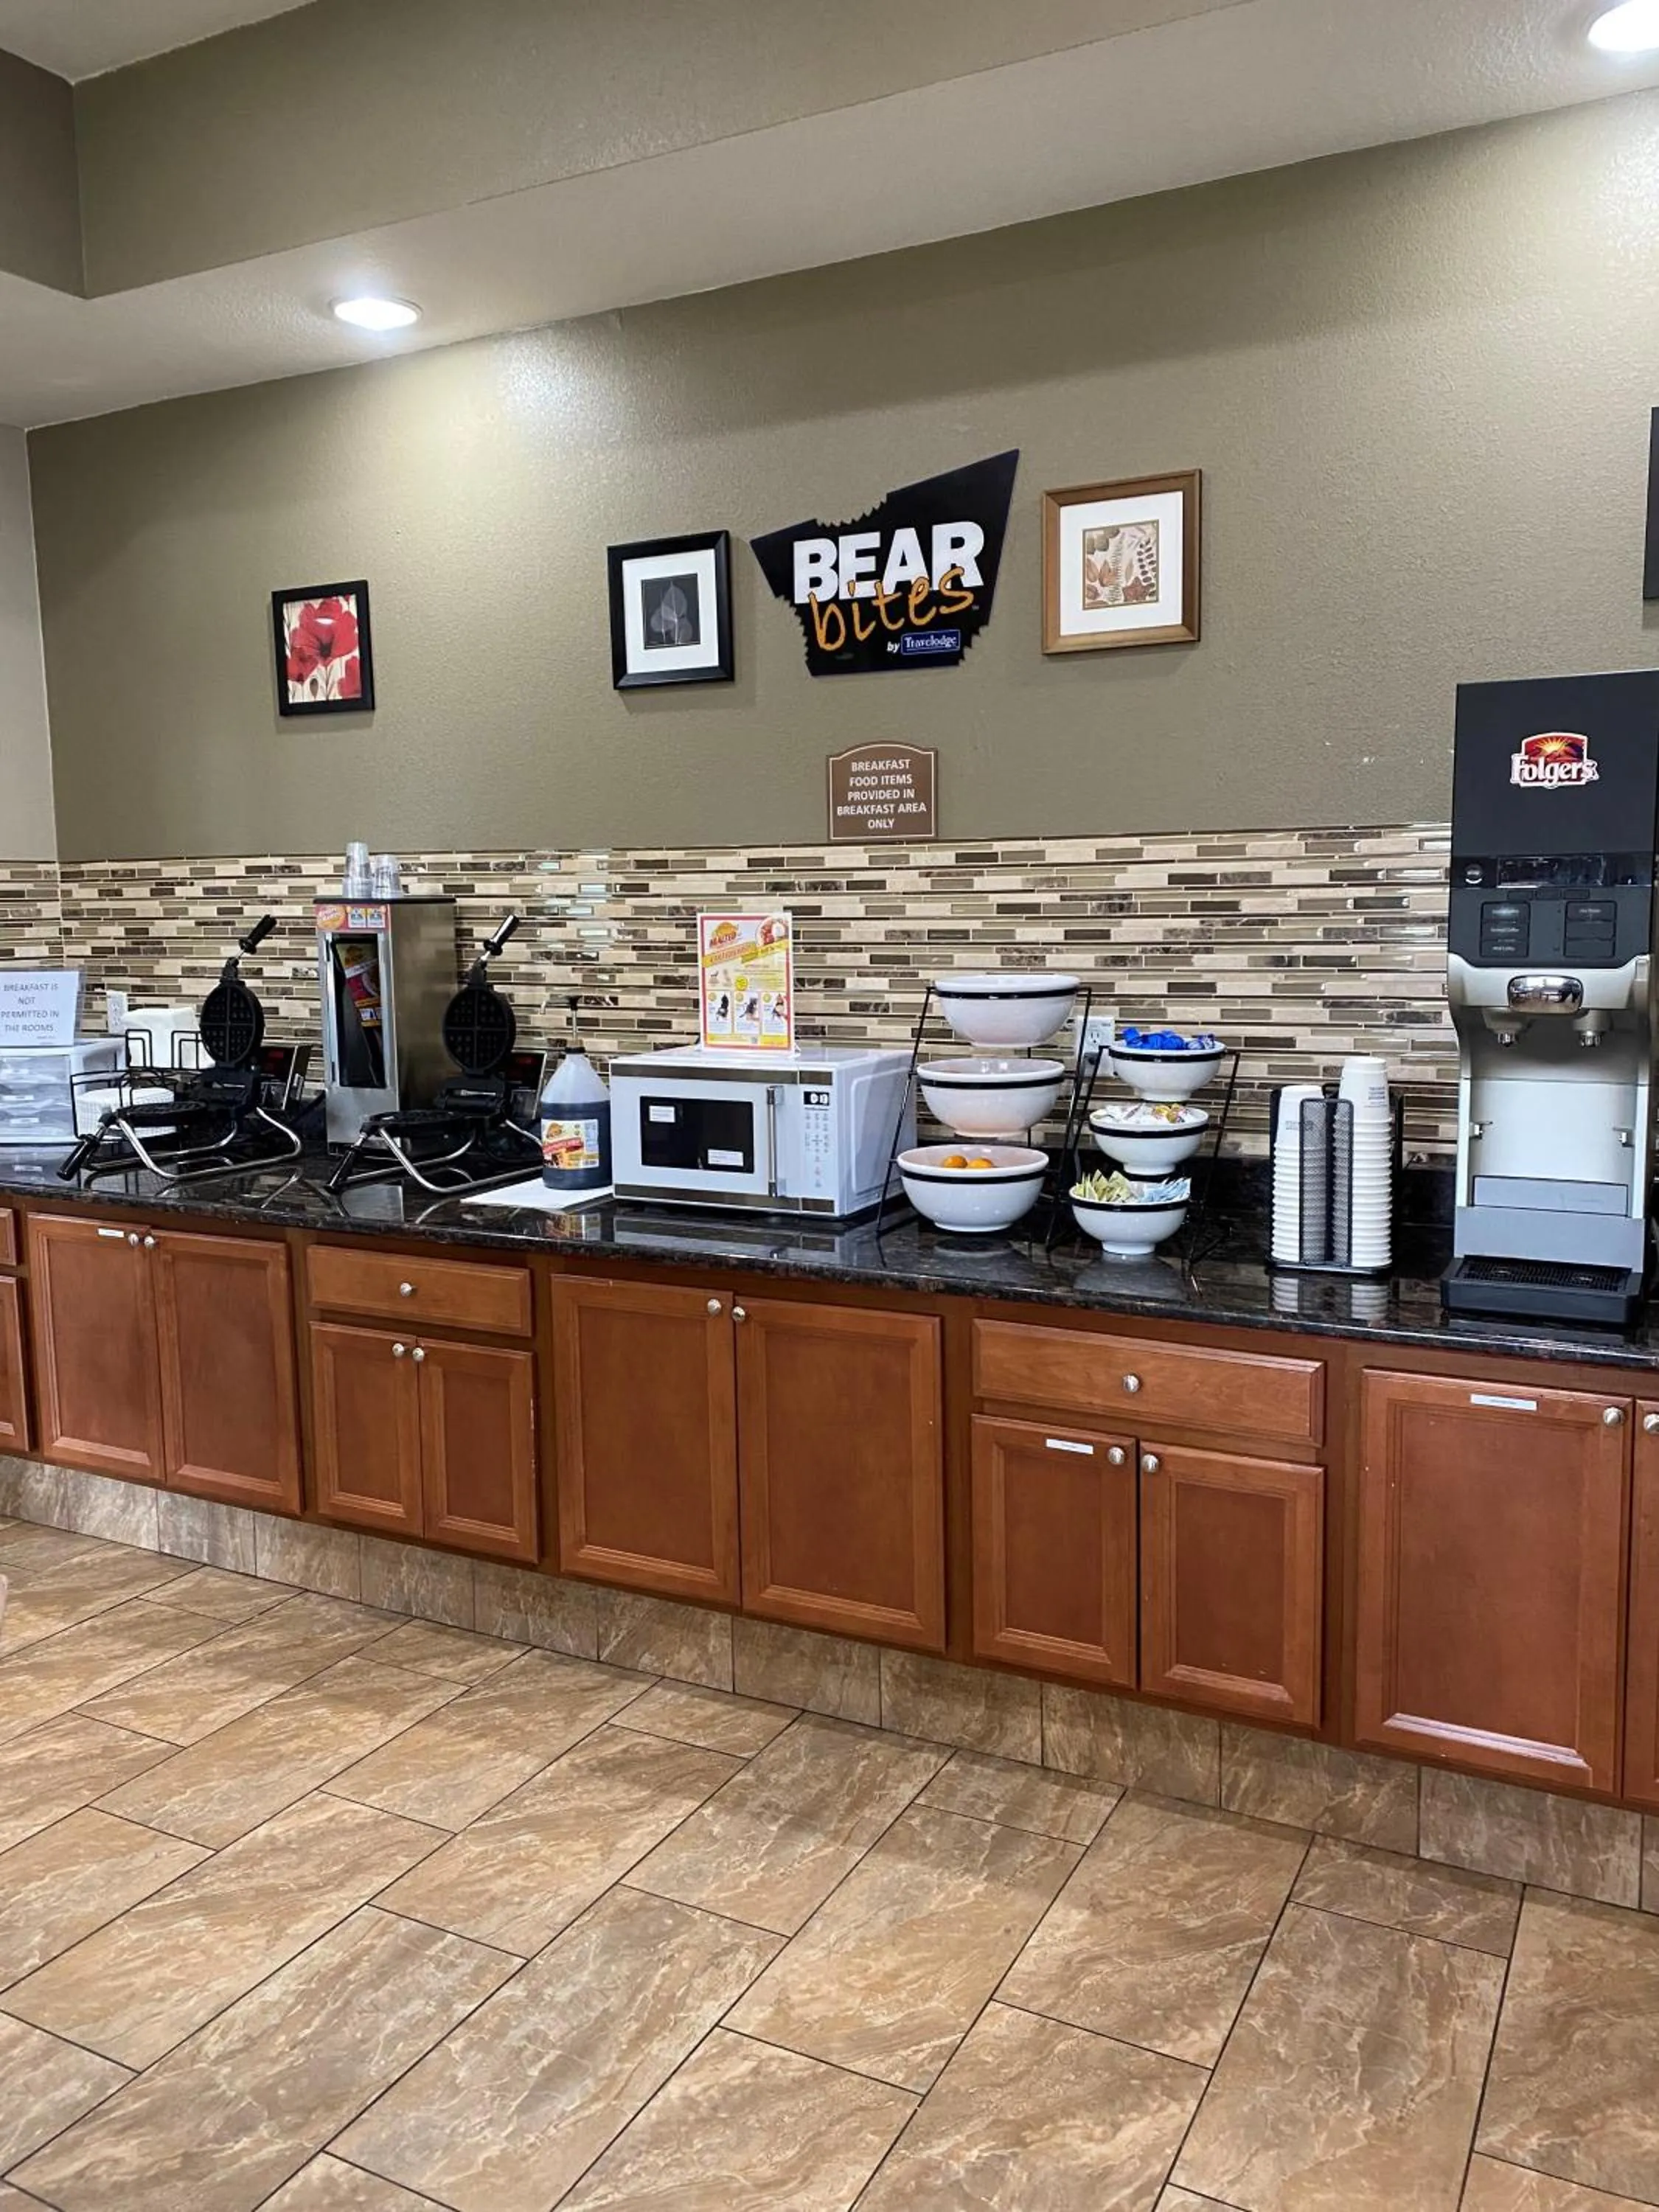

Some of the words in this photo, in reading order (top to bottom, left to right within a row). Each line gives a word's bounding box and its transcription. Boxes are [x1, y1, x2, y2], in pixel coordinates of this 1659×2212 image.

[793, 521, 984, 605] BEAR
[808, 567, 974, 651] bites
[886, 641, 900, 653] by
[904, 633, 958, 649] Travelodge
[852, 759, 911, 772] BREAKFAST
[1510, 753, 1598, 787] Folgers
[849, 776, 878, 787] FOOD
[881, 774, 913, 785] ITEMS
[848, 790, 900, 801] PROVIDED
[903, 788, 915, 799] IN
[837, 804, 895, 816] BREAKFAST
[897, 801, 927, 813] AREA
[868, 818, 894, 830] ONLY
[4, 983, 49, 992] BREAKFAST
[51, 983, 59, 992] IS
[18, 997, 36, 1005] NOT
[1, 1010, 48, 1018] PERMITTED
[5, 1024, 20, 1032] THE
